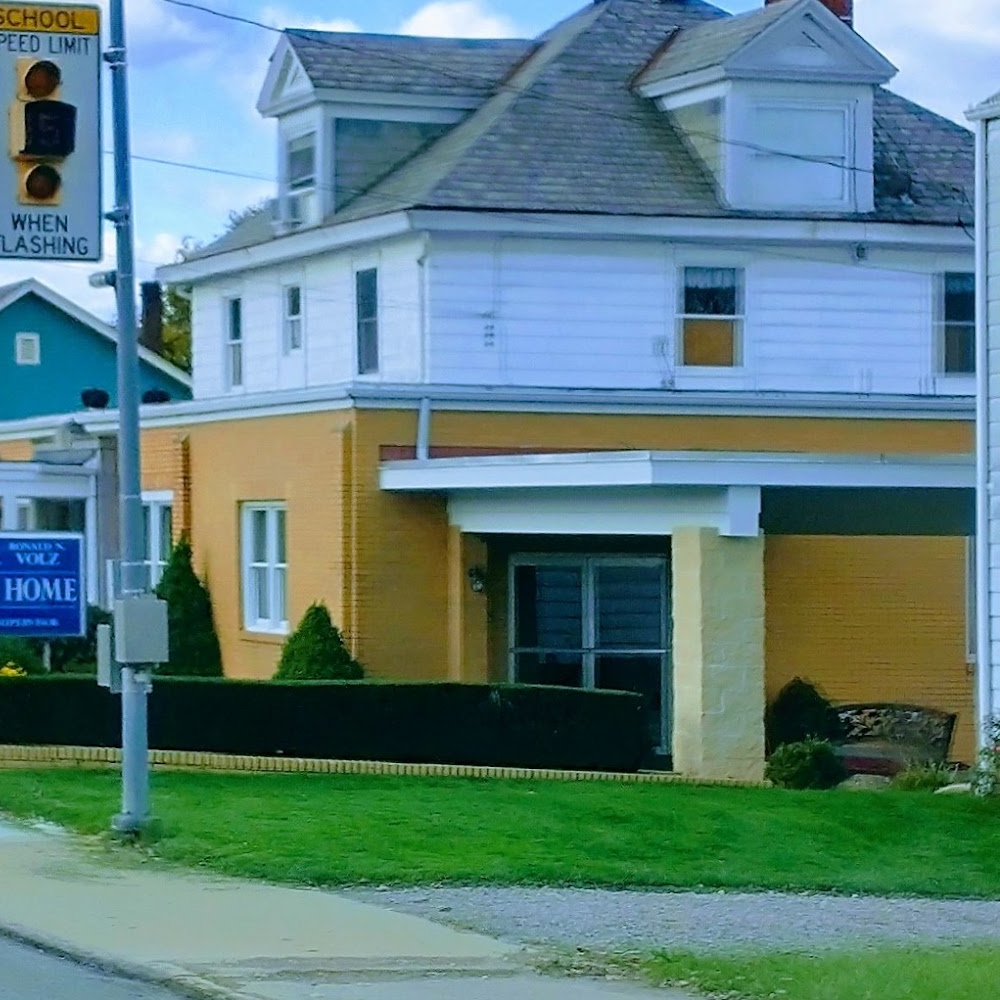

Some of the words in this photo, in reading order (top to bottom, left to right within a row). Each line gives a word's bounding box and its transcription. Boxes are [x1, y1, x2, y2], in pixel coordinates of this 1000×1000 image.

[50, 36, 90, 55] LIMIT
[12, 213, 68, 233] WHEN
[15, 552, 61, 565] VOLZ
[5, 578, 78, 602] HOME
